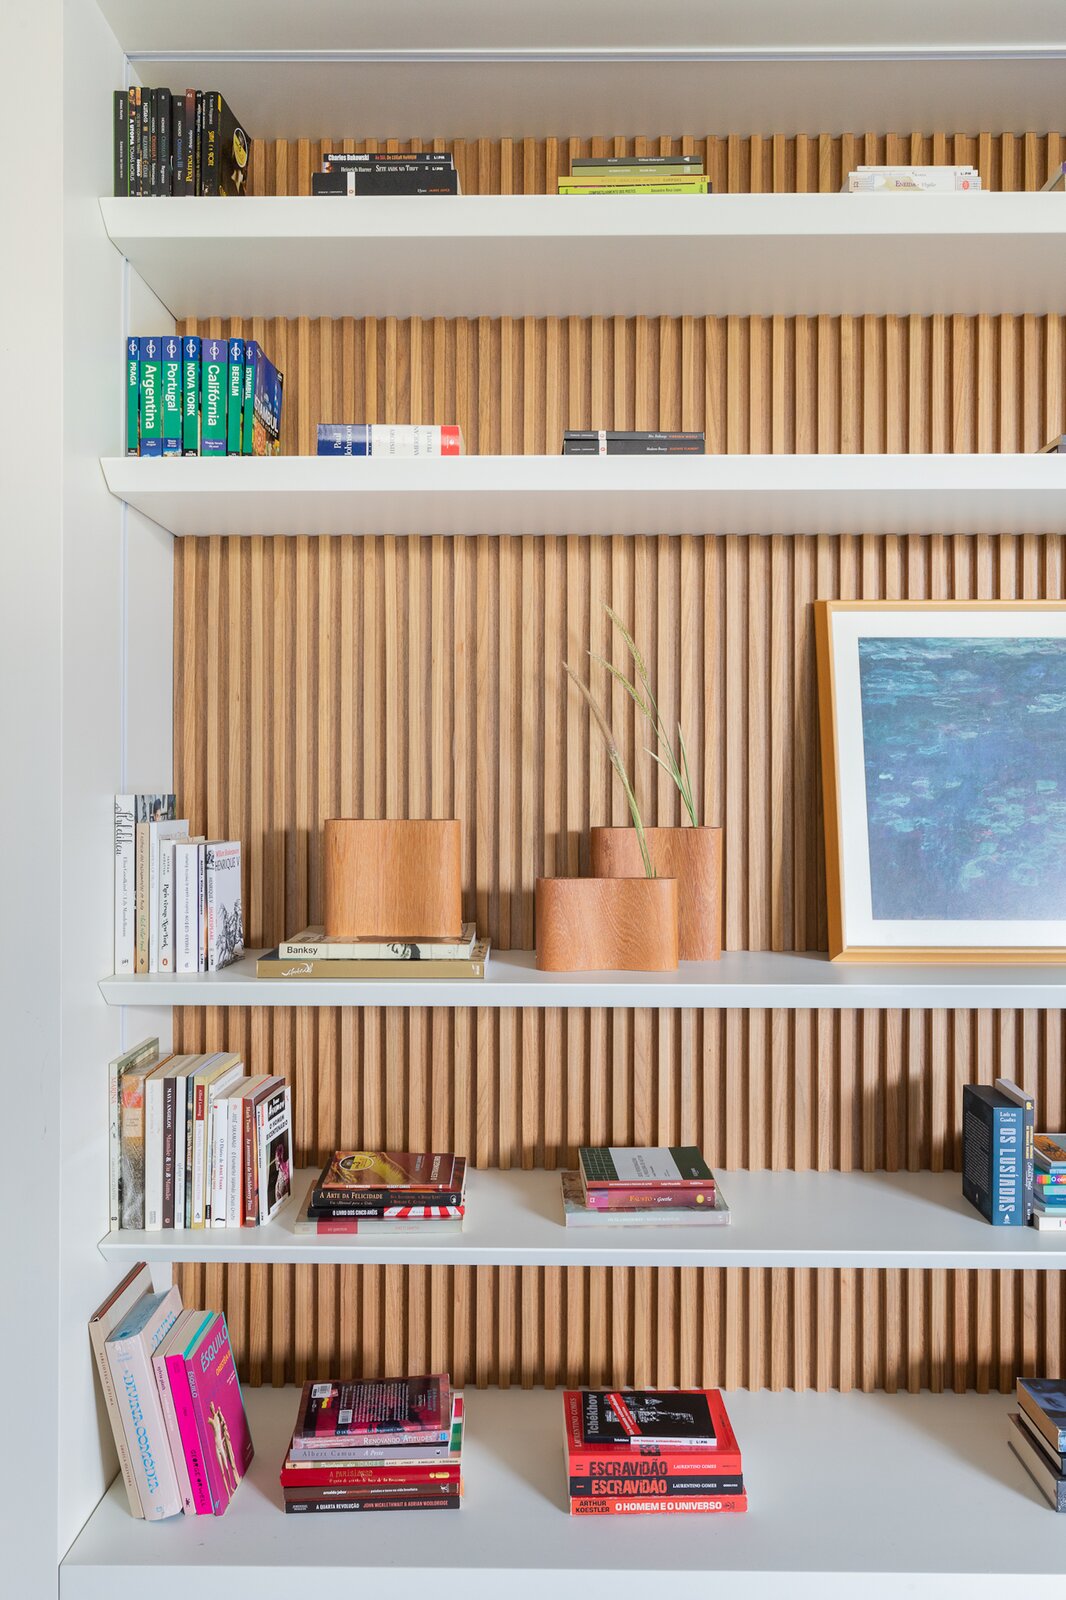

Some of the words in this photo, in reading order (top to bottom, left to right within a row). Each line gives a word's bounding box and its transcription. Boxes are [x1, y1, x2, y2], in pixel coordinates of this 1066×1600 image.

[164, 363, 178, 412] Portugal
[187, 362, 196, 390] NOVA
[142, 364, 158, 430] Argentina
[187, 391, 196, 417] YORK
[208, 364, 220, 426] Califórnia
[334, 433, 342, 449] Paul
[344, 425, 353, 456] Johnson
[215, 858, 236, 872] HENRIQUE
[286, 946, 318, 954] Banksy
[1000, 1128, 1016, 1144] OS
[999, 1148, 1018, 1212] LUSÍADAS
[200, 1325, 228, 1372] ÉSQUILO
[588, 1394, 598, 1434] Tchékhov
[123, 1374, 144, 1427] DIVINA
[136, 1427, 160, 1494] COMÉDIA
[363, 1436, 400, 1446] RENOVANDO
[402, 1434, 434, 1444] ATITUDES
[572, 1416, 582, 1448] LAURENTINO
[190, 1450, 200, 1478] GEORGE
[197, 1478, 206, 1508] ORWELL
[330, 1470, 334, 1478] A
[589, 1458, 668, 1476] ESCRAVIDÃO
[591, 1478, 668, 1494] ESCRAVIDÃO
[615, 1502, 620, 1510] O
[622, 1502, 660, 1510] HOMEM
[660, 1502, 666, 1510] E
[667, 1502, 674, 1510] O
[674, 1502, 722, 1510] UNIVERSO
